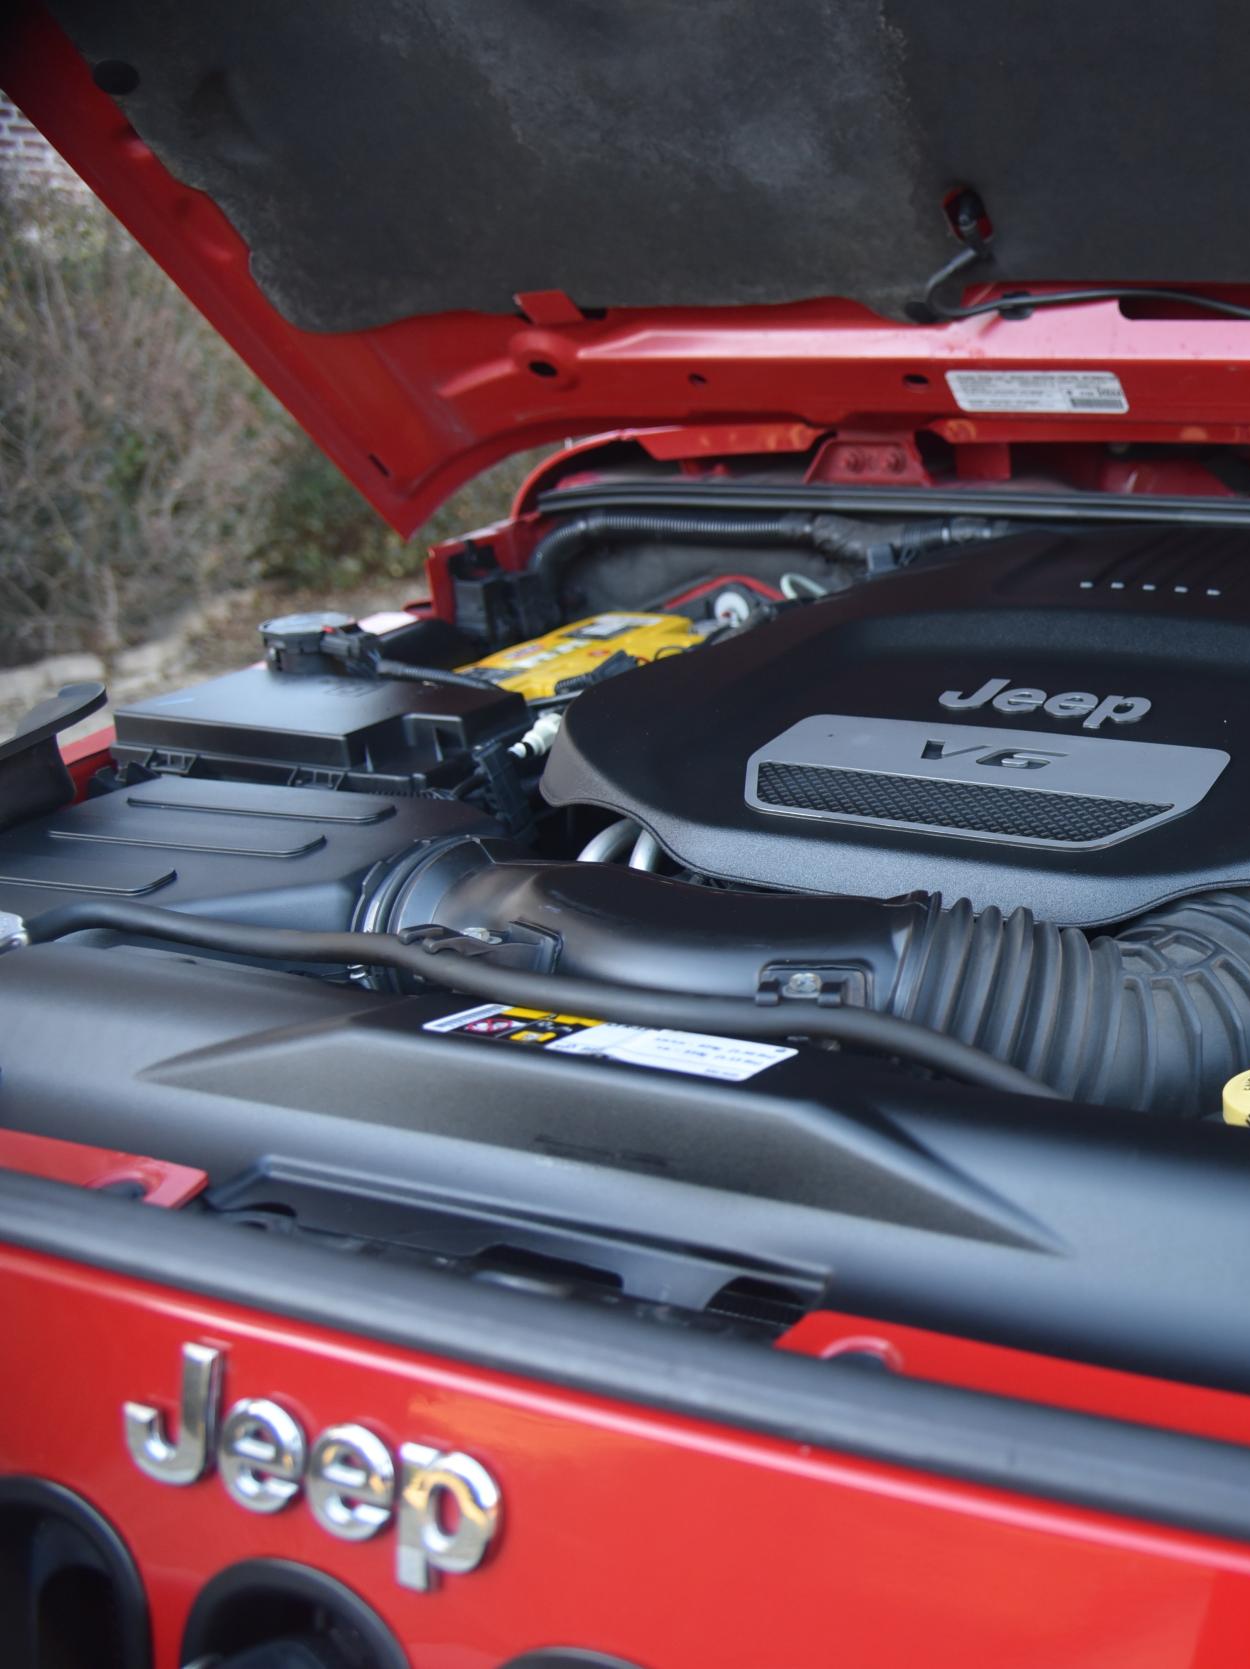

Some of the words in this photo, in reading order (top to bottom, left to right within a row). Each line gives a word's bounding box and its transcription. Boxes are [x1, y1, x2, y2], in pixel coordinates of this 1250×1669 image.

[938, 678, 1152, 730] Jeep
[920, 740, 1068, 770] V6
[123, 1340, 500, 1592] Jeep
